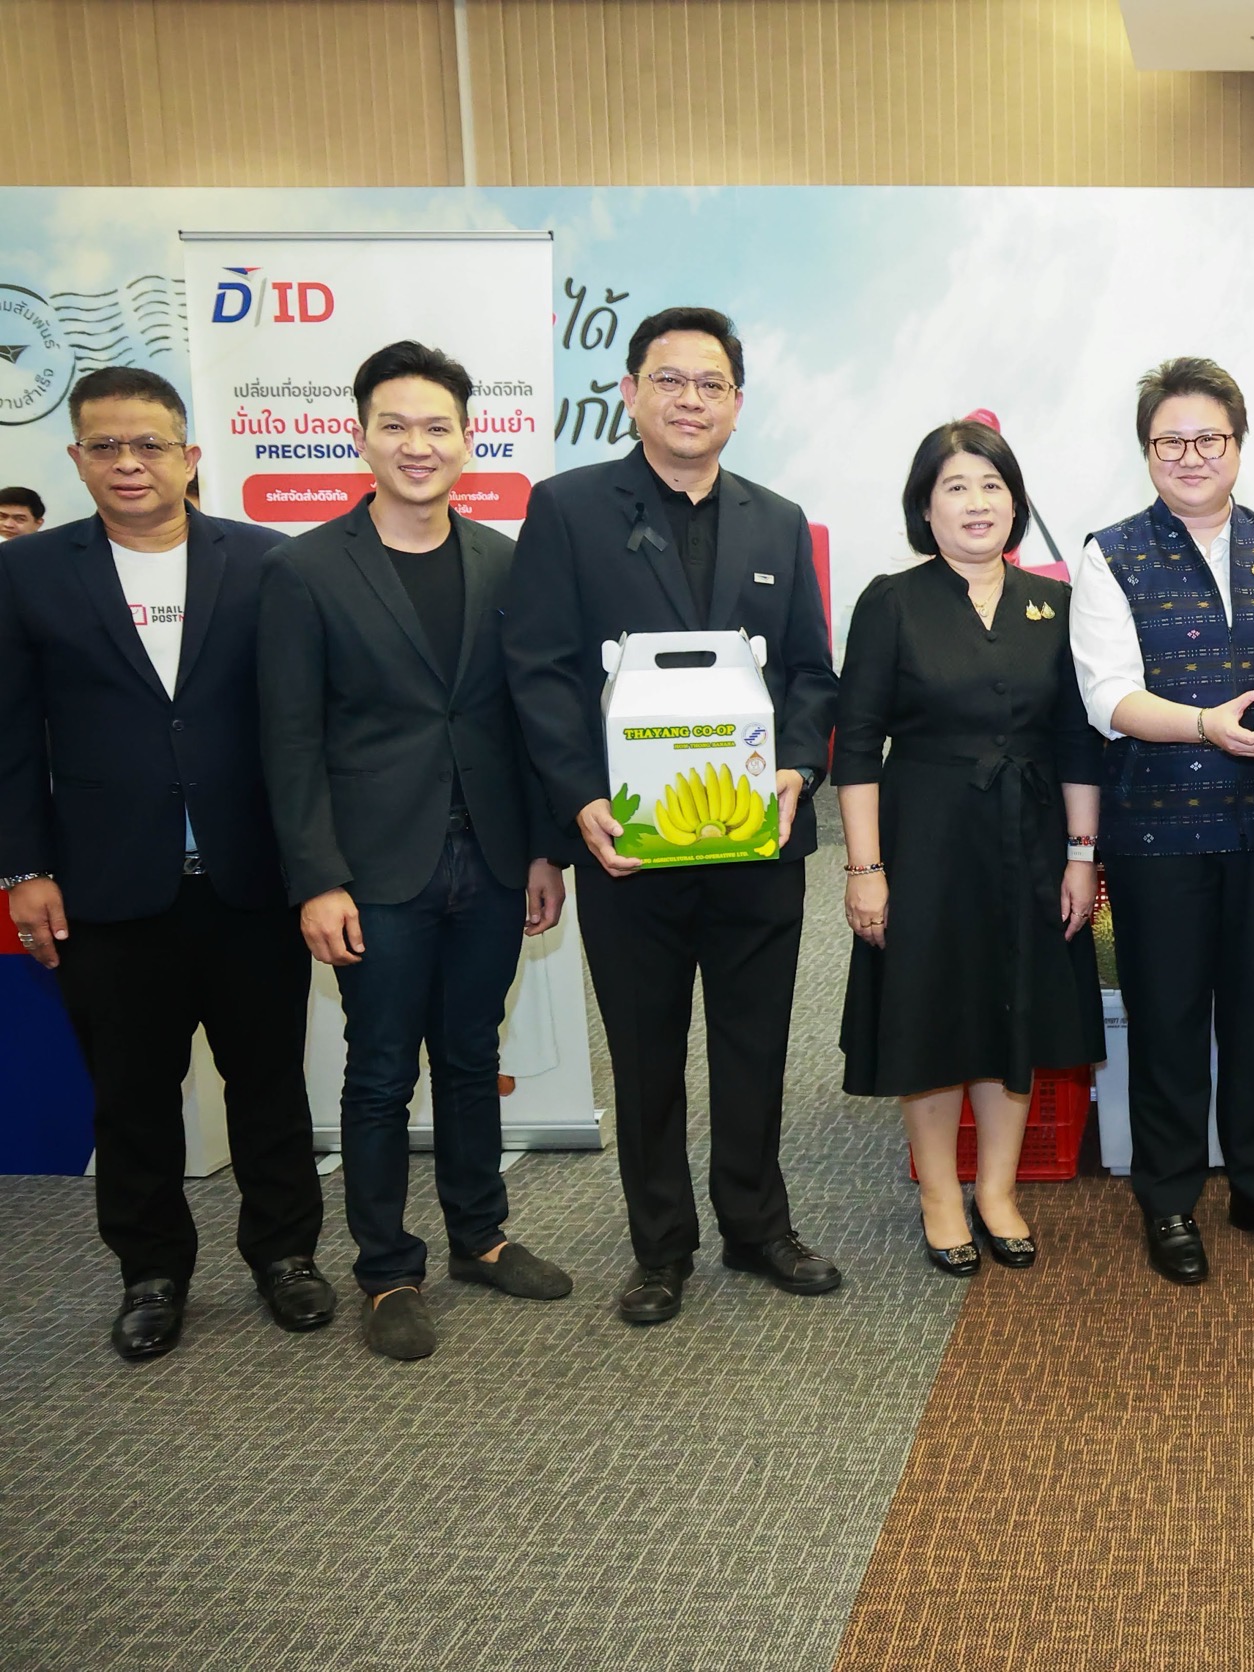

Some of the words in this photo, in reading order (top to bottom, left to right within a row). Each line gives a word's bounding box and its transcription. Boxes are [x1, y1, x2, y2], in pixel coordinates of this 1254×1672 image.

[0, 300, 60, 350] มสัมพันธ์
[563, 277, 629, 350] ได้
[231, 405, 286, 435] มั่นใจ
[467, 409, 535, 433] ม่นยำ
[475, 443, 514, 458] OVE
[150, 605, 184, 615] THAIL
[624, 726, 690, 740] THAYANG
[693, 724, 736, 737] CO-OP
